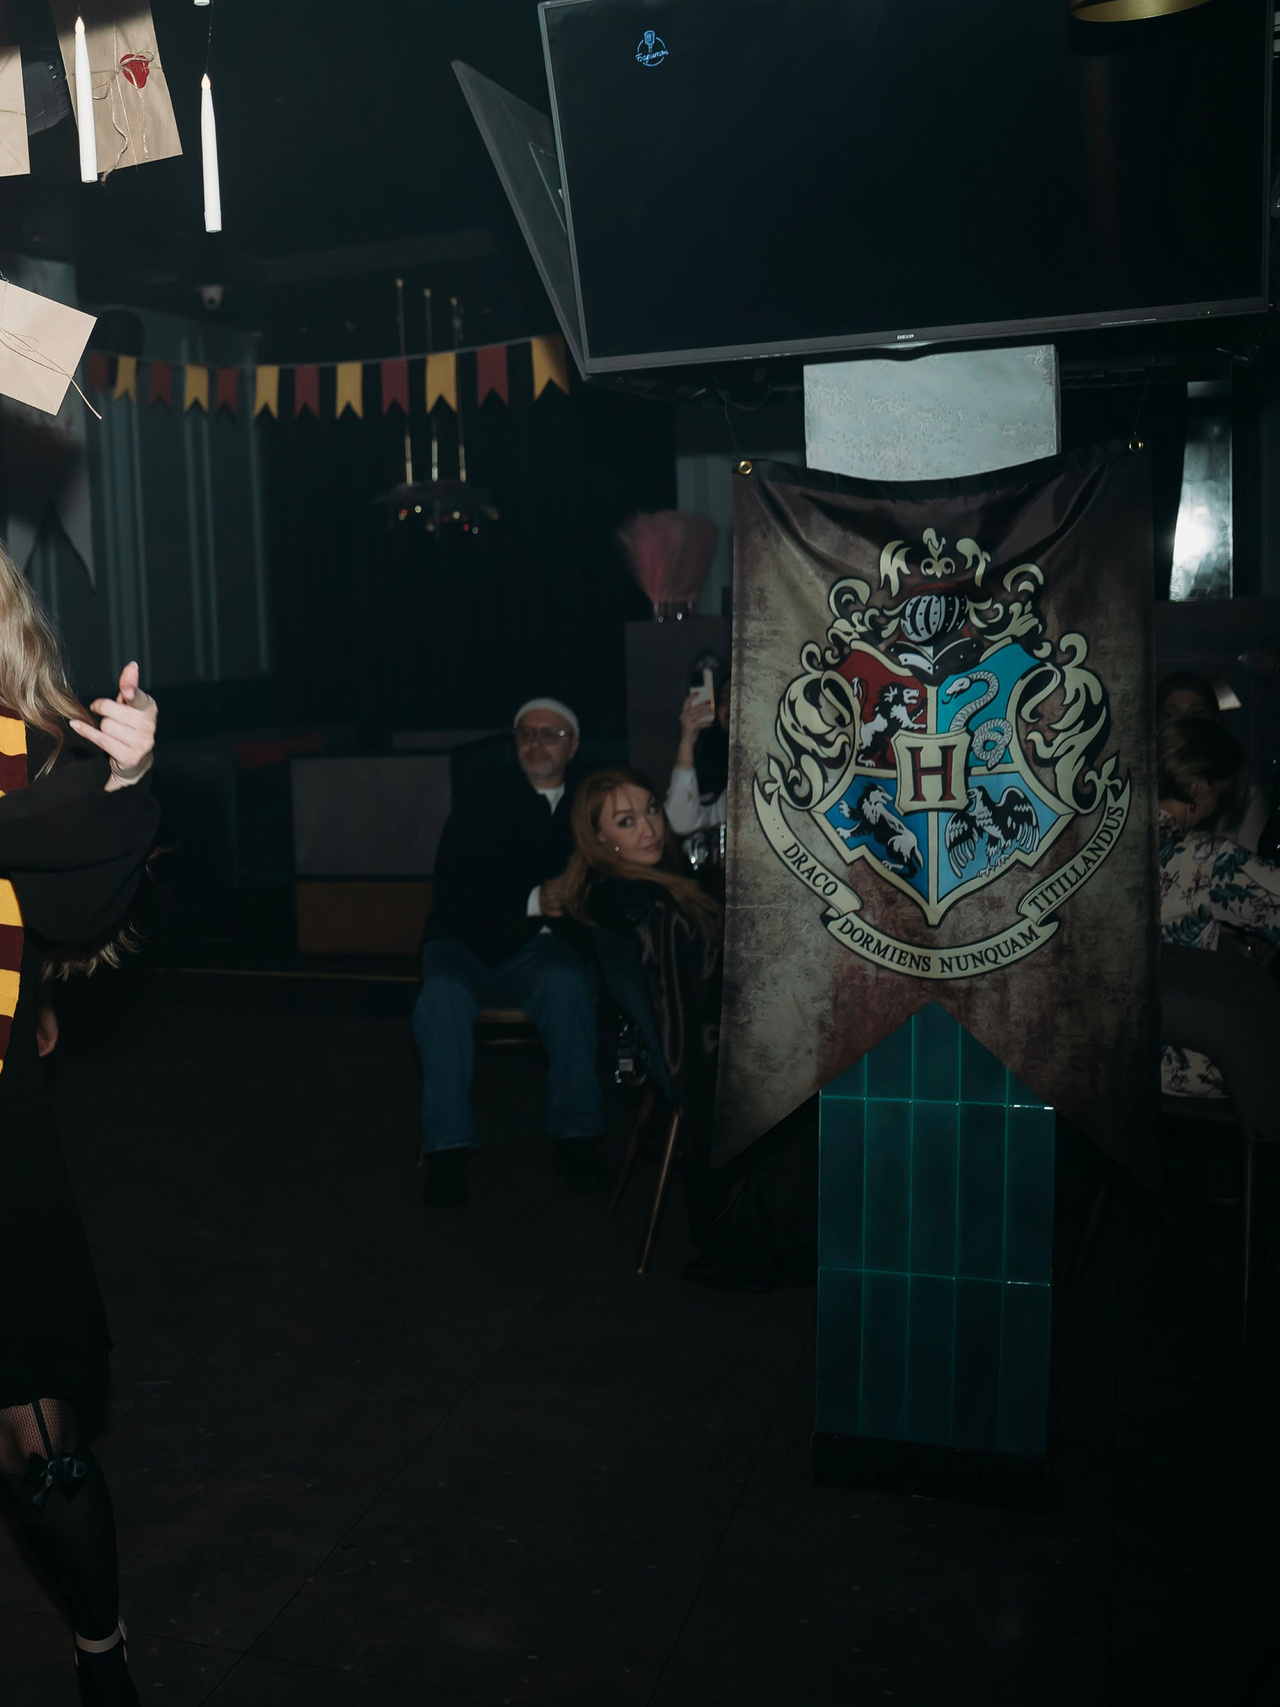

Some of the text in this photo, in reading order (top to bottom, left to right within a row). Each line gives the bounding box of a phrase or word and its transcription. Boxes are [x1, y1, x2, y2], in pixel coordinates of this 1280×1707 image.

[905, 744, 958, 802] H
[783, 806, 1124, 973] DRACO DORMIENS NUNQUAM TITILLANDUS
